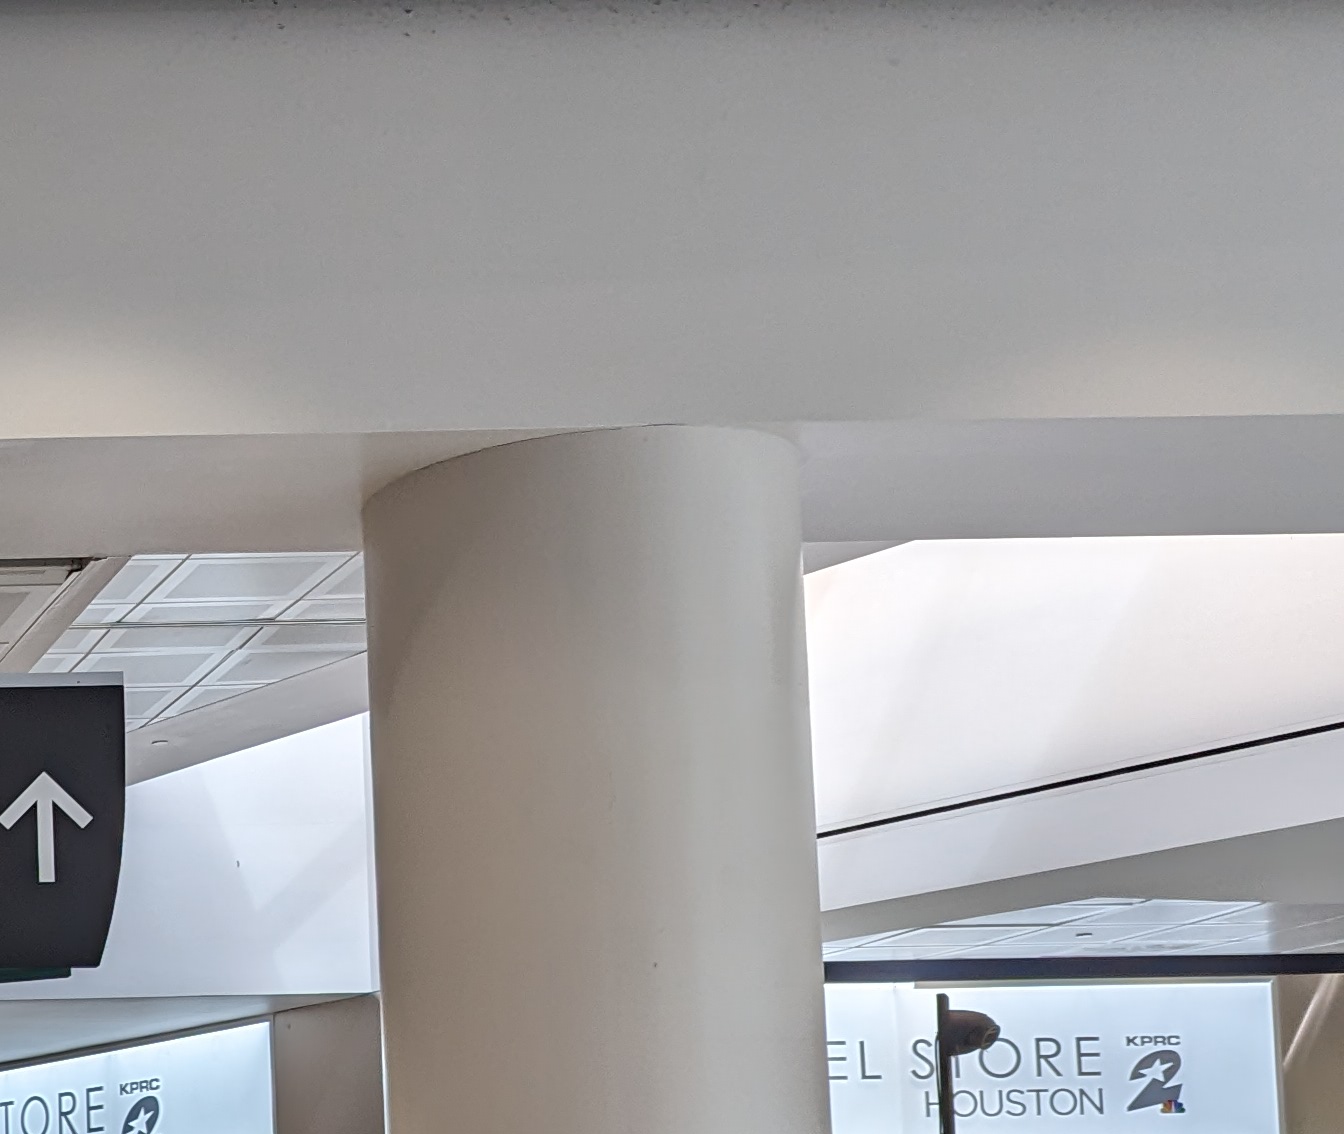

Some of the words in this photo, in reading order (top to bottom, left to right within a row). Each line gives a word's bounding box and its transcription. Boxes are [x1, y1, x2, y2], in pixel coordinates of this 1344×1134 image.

[1125, 1035, 1182, 1047] KPRC
[119, 1078, 161, 1096] KPRC
[1125, 1049, 1184, 1112] 2
